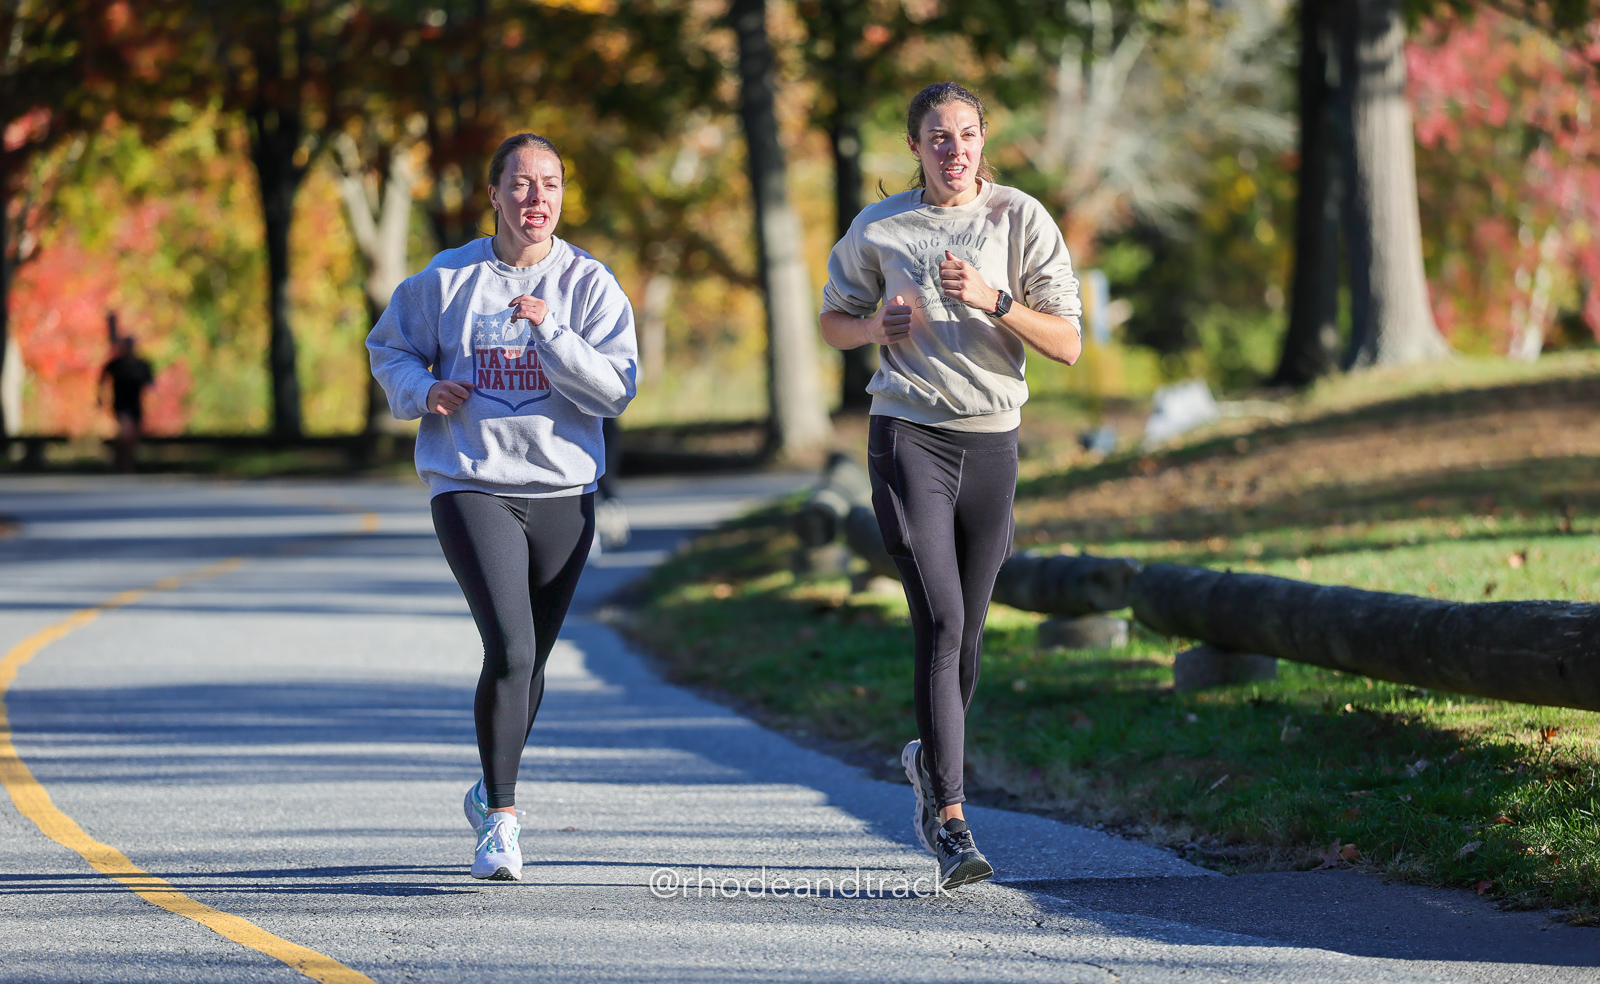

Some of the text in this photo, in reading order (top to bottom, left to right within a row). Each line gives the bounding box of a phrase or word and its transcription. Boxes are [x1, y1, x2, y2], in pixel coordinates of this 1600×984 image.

[906, 232, 988, 256] DOG MOM
[475, 349, 543, 369] TAYLO
[477, 369, 550, 390] NATION
